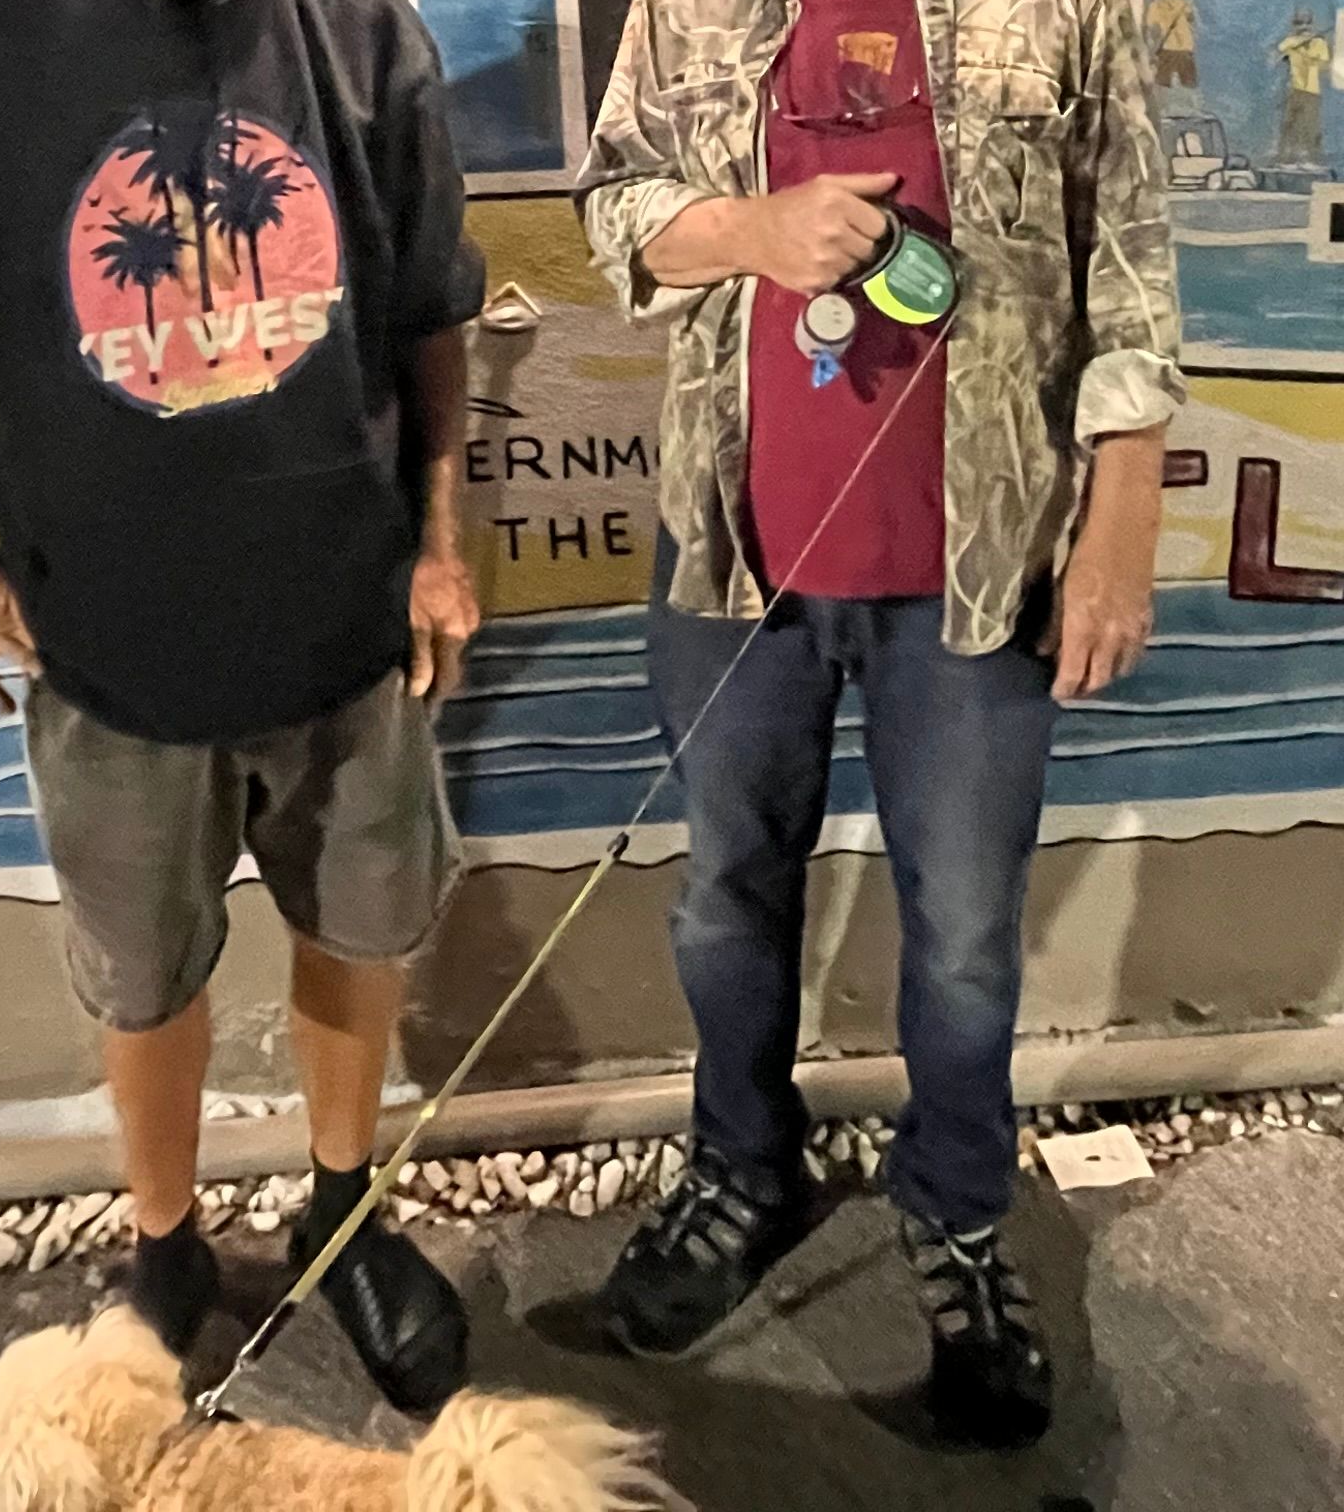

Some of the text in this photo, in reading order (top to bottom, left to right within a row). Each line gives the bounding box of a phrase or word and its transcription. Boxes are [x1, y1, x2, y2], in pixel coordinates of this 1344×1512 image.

[79, 321, 173, 382] EY
[464, 435, 660, 483] ERNM
[494, 511, 634, 562] THE
